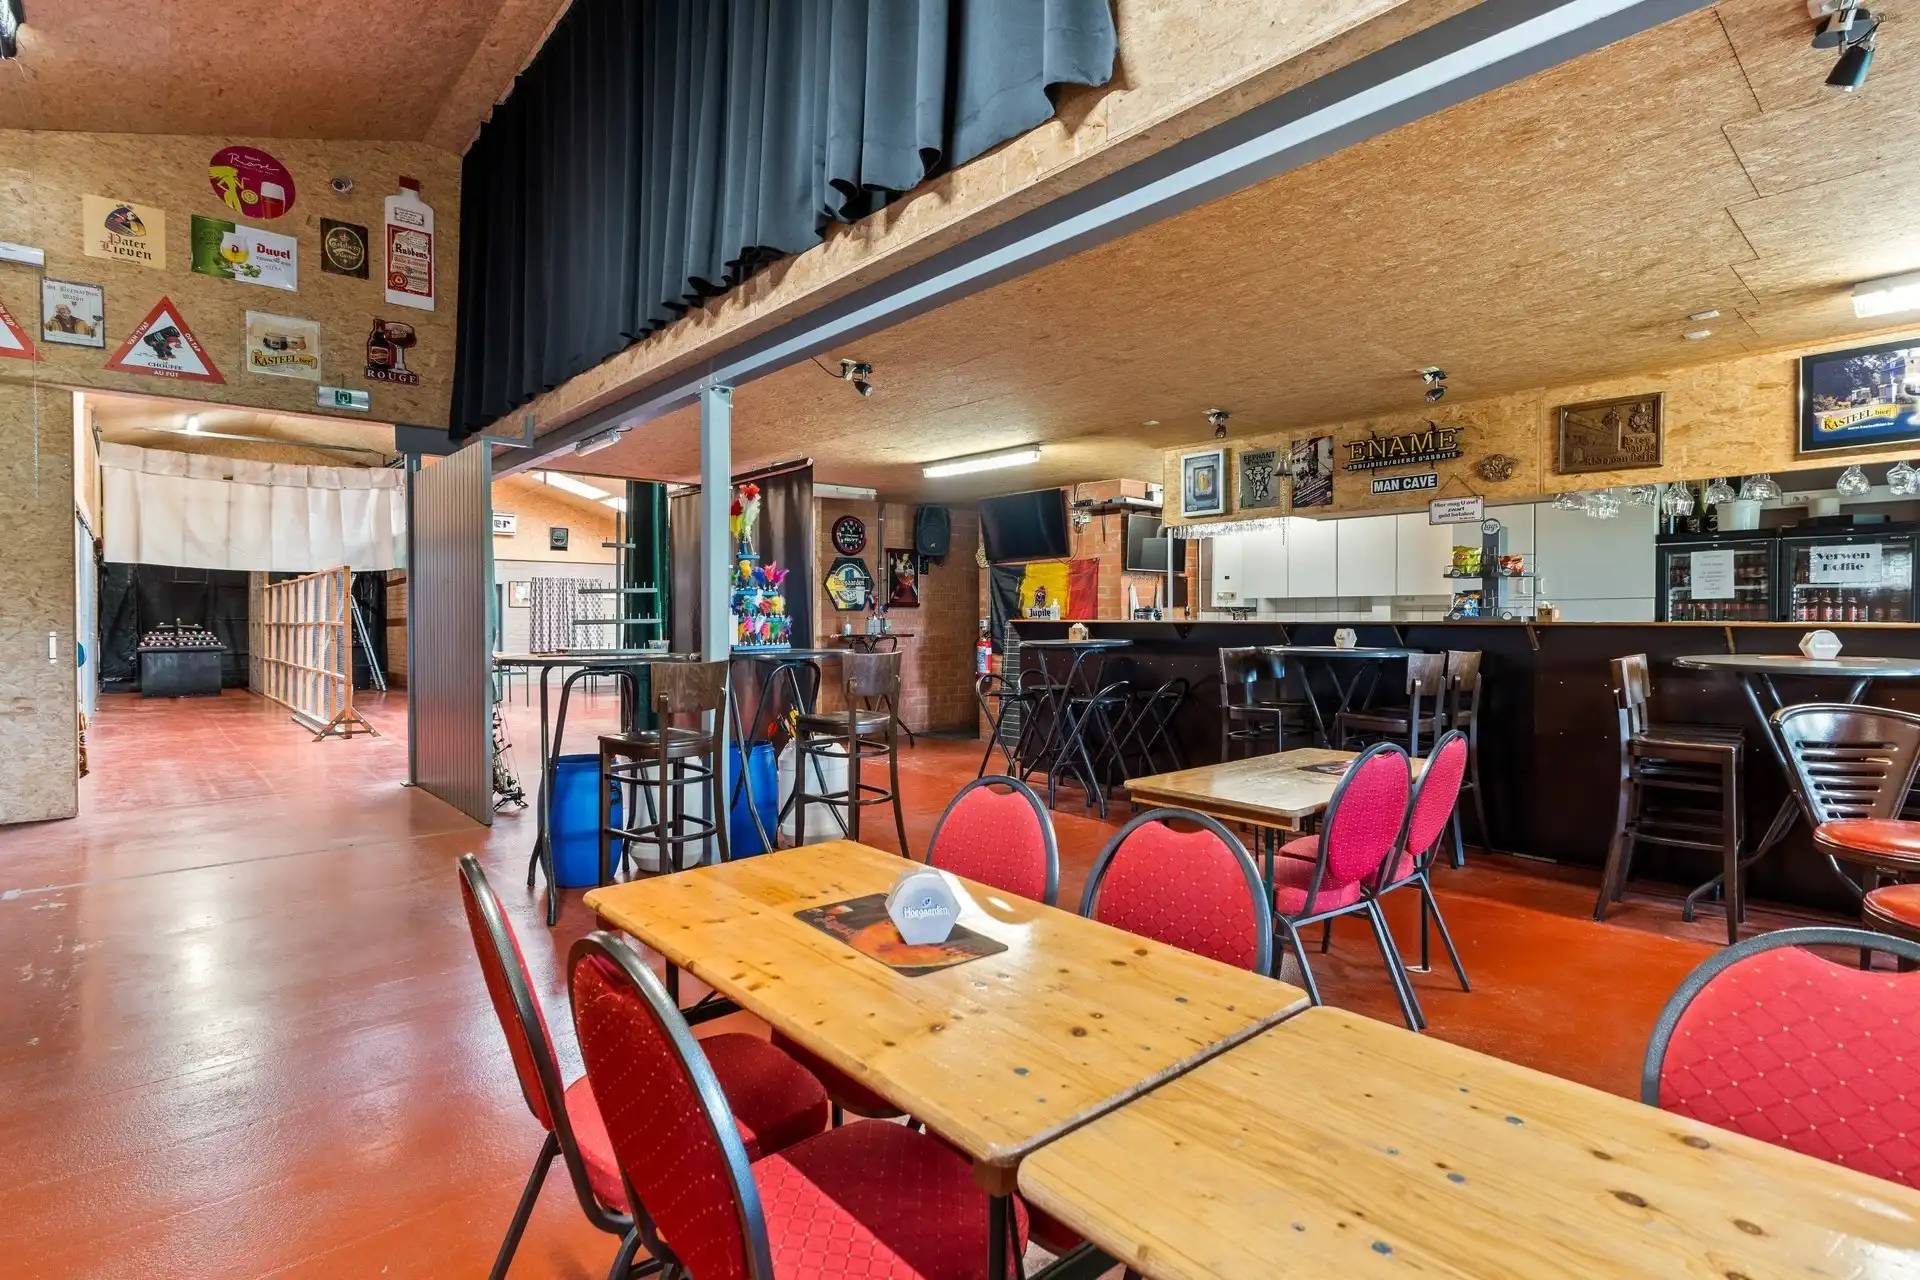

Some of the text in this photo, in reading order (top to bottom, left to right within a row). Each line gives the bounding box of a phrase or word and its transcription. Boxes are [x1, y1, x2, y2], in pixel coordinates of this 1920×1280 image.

[107, 232, 146, 249] Pater
[100, 240, 152, 260] Lieven
[256, 242, 291, 260] Duvel
[395, 242, 428, 259] Rubbens
[127, 336, 138, 346] VAN
[185, 332, 201, 353] ON TAP
[147, 361, 185, 371] CHOUFFE
[254, 353, 298, 366] KASTEEL
[367, 369, 417, 383] ROUGE
[1823, 409, 1873, 431] KASTEEL
[1349, 427, 1458, 463] ENAME
[1373, 475, 1436, 493] MAN CAVE
[1816, 552, 1871, 561] Verwen
[1822, 562, 1864, 572] Koffie
[1028, 608, 1053, 618] Jupile
[903, 905, 950, 920] Hoegaarden
